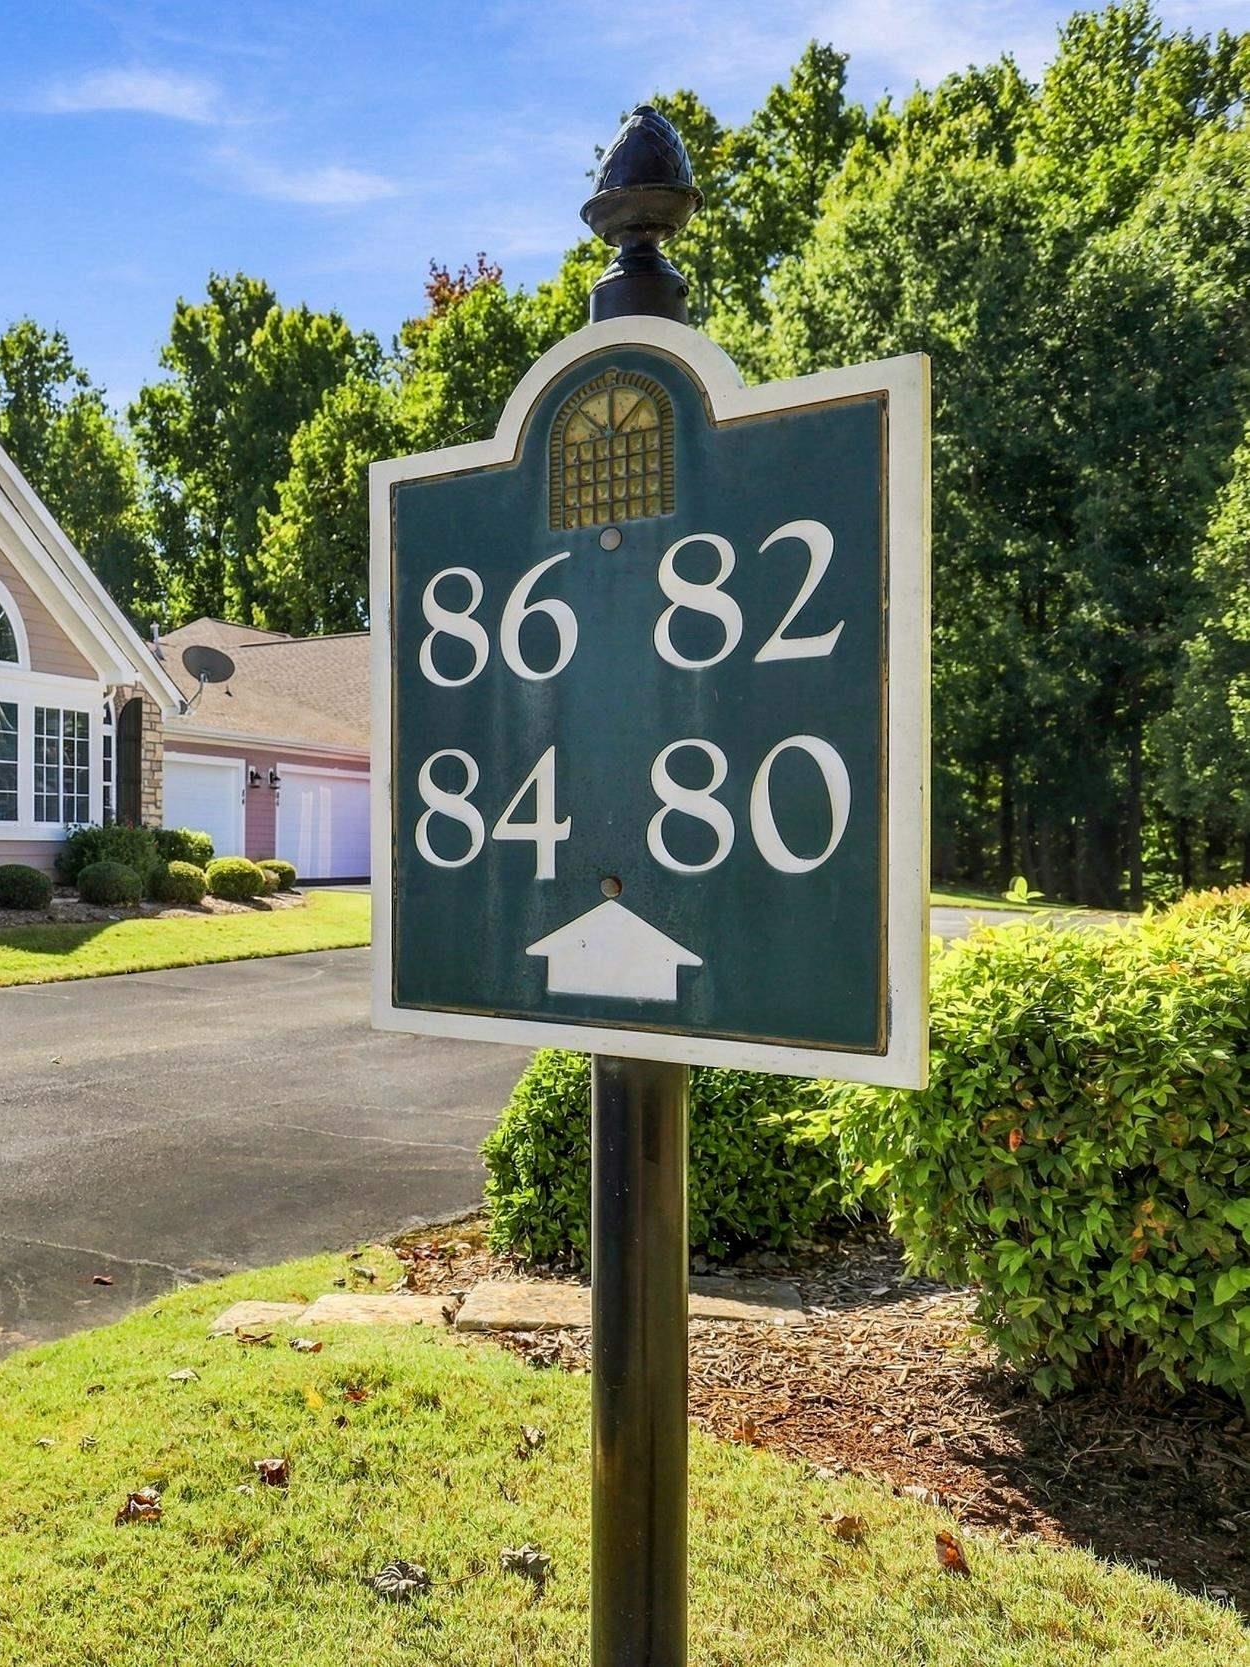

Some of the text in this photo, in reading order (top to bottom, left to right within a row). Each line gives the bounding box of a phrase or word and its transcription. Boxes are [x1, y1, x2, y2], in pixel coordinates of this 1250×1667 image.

[419, 519, 845, 687] 86 82
[415, 734, 851, 880] 84 80
